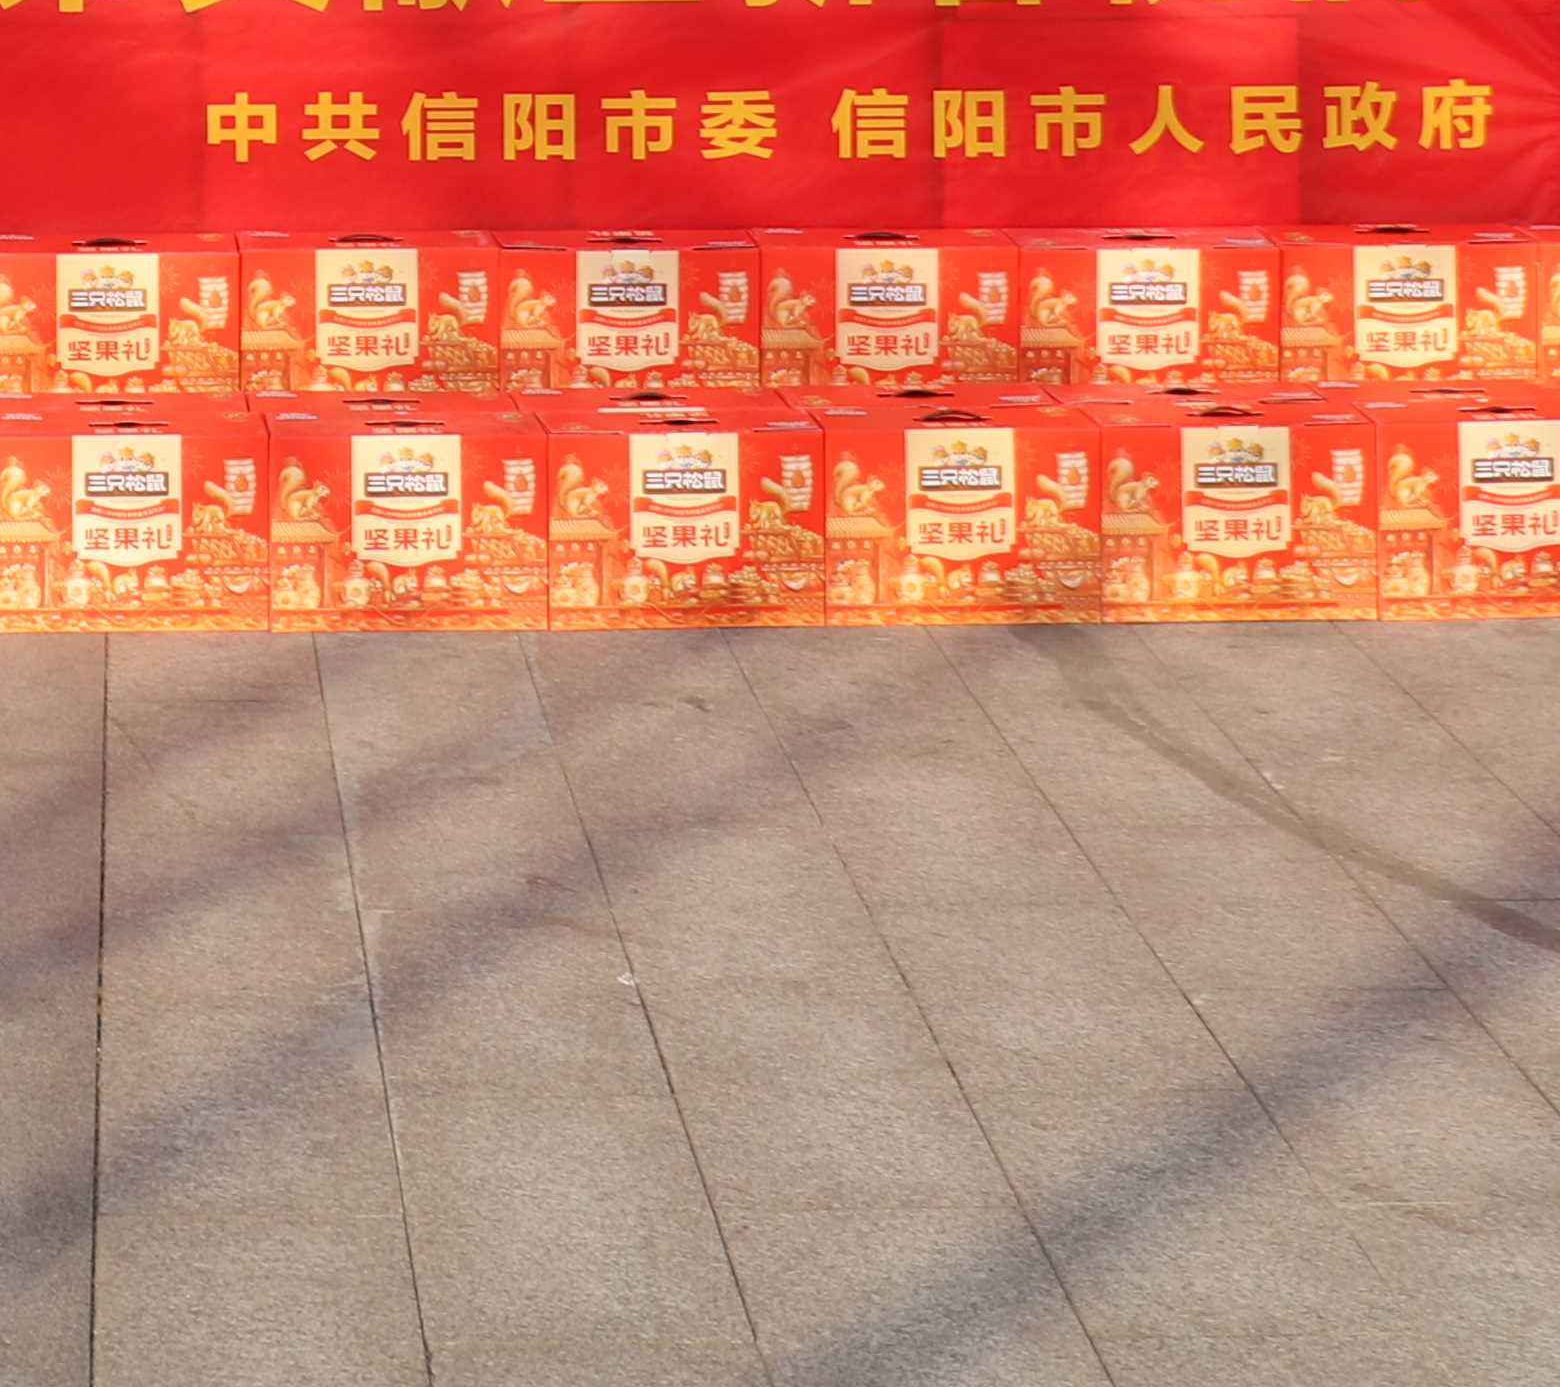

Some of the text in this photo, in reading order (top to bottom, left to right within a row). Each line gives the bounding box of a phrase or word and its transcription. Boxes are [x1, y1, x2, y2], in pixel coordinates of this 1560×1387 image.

[206, 79, 1493, 163] 中共信阳市委 信阳市人民政府
[71, 291, 145, 308] 三只松鼠
[331, 286, 405, 303] 三只松鼠
[592, 286, 664, 302] 三只松鼠
[850, 285, 926, 302] 三只松鼠
[1111, 284, 1185, 301] 三只松鼠
[1369, 281, 1443, 298] 三只松鼠
[68, 340, 150, 361] 坚果礼
[327, 335, 409, 356] 坚果礼
[588, 335, 670, 356] 坚果礼
[847, 335, 929, 356] 坚果礼
[1108, 334, 1190, 355] 坚果礼
[1366, 331, 1448, 352] 坚果礼
[921, 468, 1000, 486] 三只松鼠
[1197, 465, 1276, 483] 三只松鼠
[1474, 460, 1553, 478] 三只松鼠
[88, 474, 167, 492] 三只松鼠
[366, 474, 447, 492] 三只松鼠
[645, 471, 726, 489] 三只松鼠
[918, 521, 1005, 544] 坚果礼
[1195, 519, 1280, 541] 坚果礼
[1471, 513, 1558, 536] 坚果礼
[84, 527, 171, 550] 坚果礼
[363, 527, 452, 551] 坚果礼
[642, 525, 729, 548] 坚果礼
